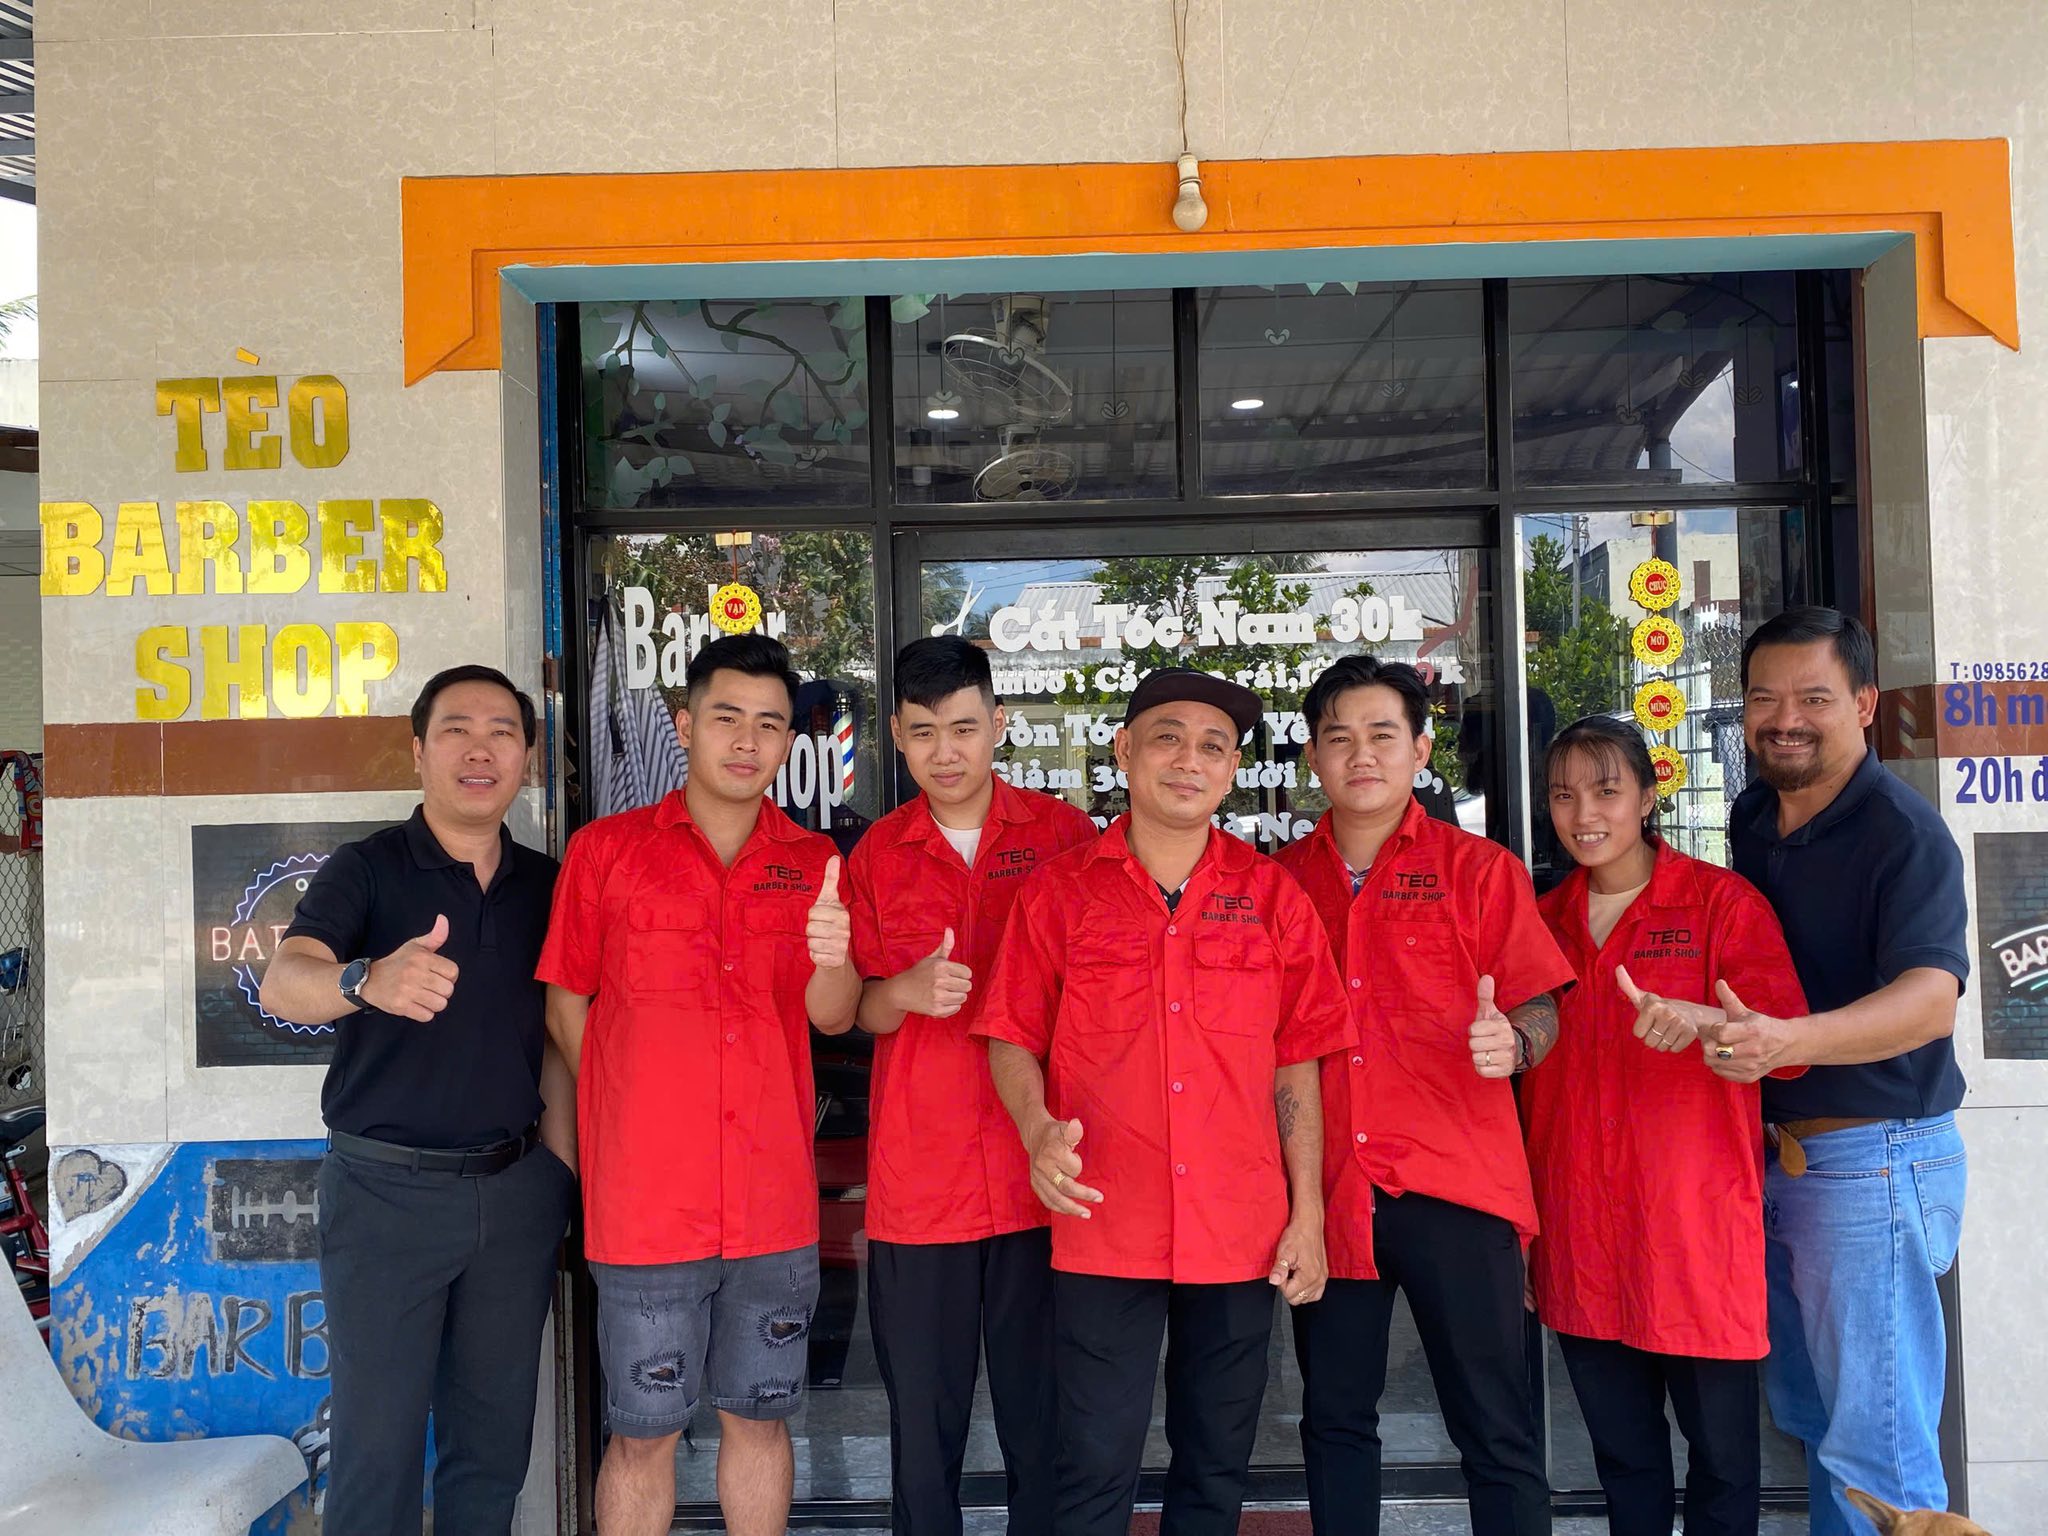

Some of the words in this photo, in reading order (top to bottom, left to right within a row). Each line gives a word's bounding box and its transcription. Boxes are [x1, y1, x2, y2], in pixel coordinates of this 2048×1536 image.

[156, 347, 349, 473] TÈO
[39, 498, 448, 597] BARBER
[1093, 604, 1184, 649] Tóc
[1197, 599, 1317, 647] Nam
[1330, 595, 1424, 643] 30k
[135, 621, 400, 721] SHOP
[1944, 681, 1998, 727] 8h
[1956, 757, 2023, 804] 20h
[753, 881, 789, 892] BARBER
[790, 883, 813, 893] SHOP
[1382, 889, 1420, 900] BARBER
[1421, 891, 1446, 902] SHOP
[1201, 911, 1239, 923] BARBER
[1240, 914, 1262, 925] SHO
[1633, 949, 1672, 960] BARBER
